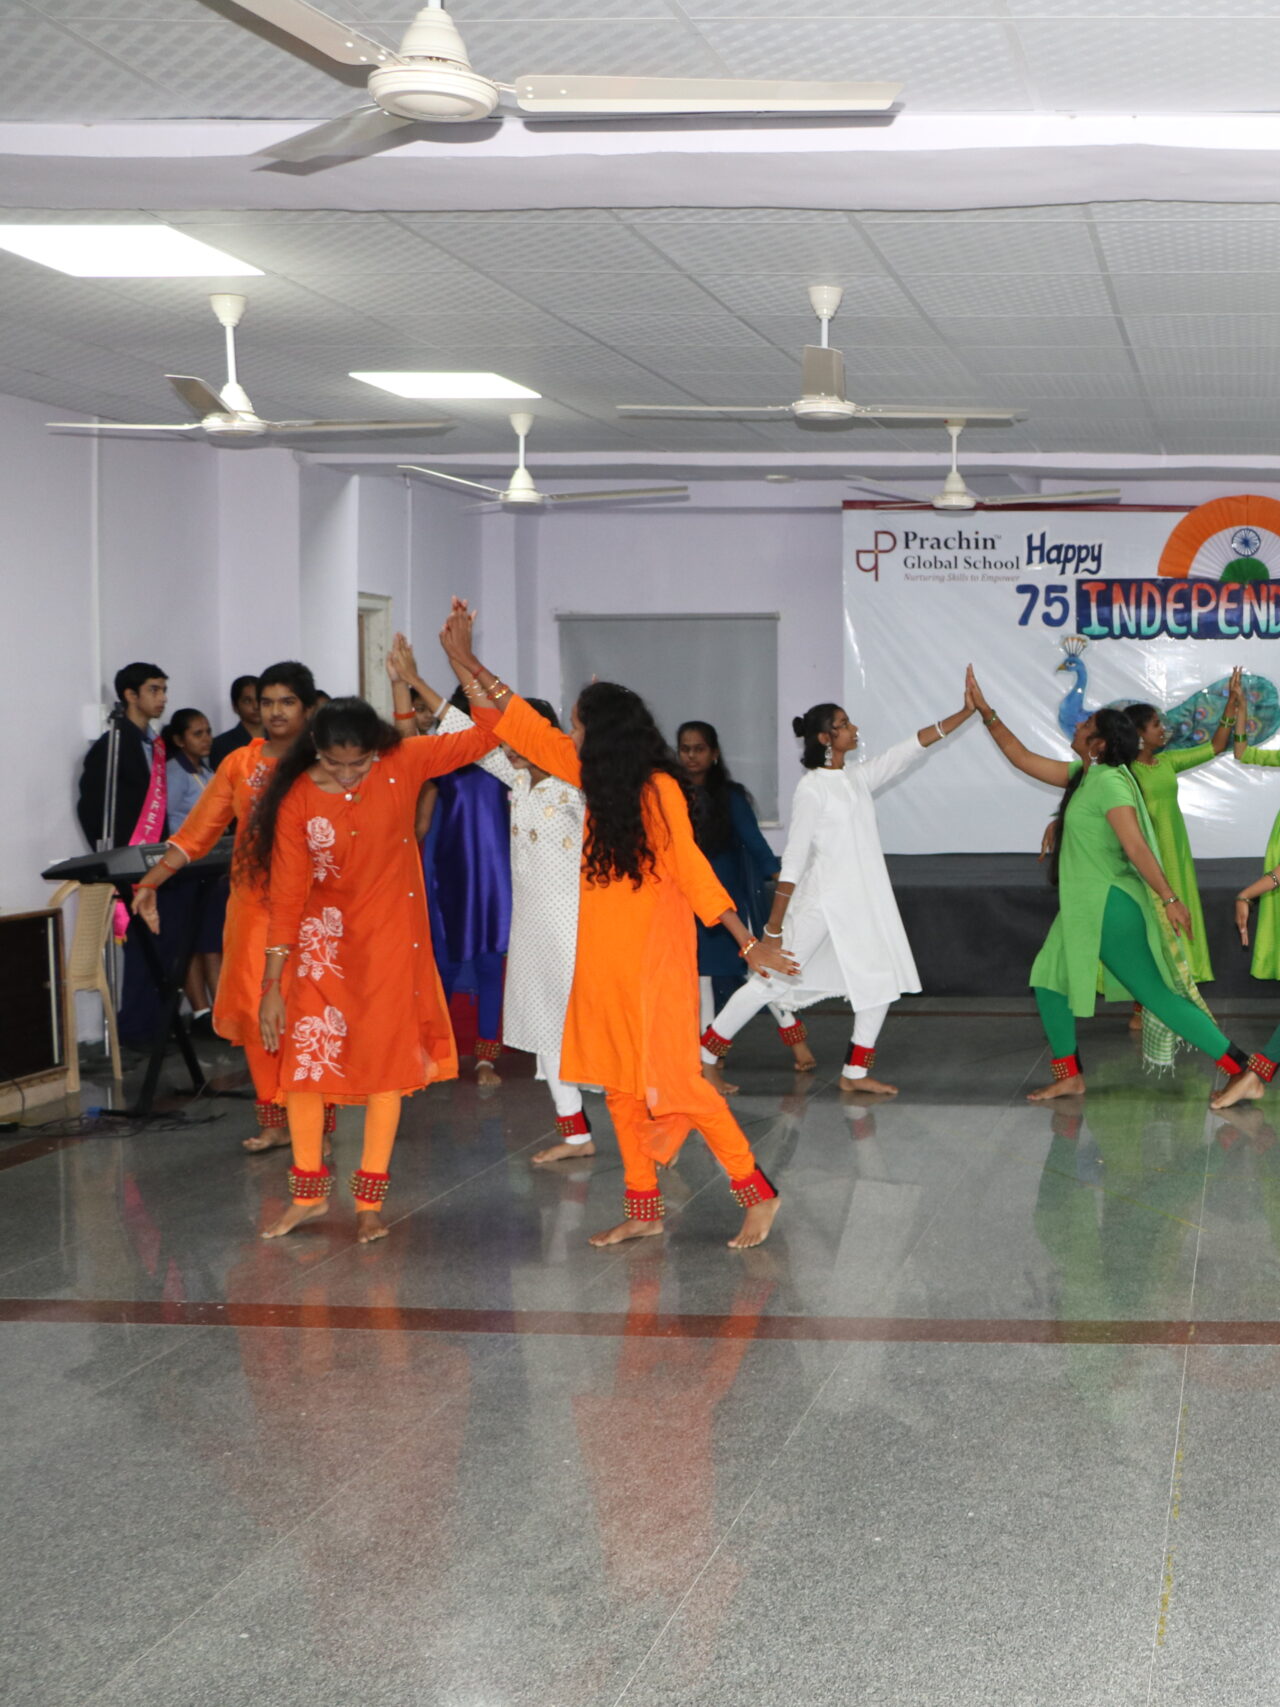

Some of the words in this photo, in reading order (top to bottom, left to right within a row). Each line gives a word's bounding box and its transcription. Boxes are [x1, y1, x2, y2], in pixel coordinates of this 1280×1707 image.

[903, 530, 997, 550] Prachin
[903, 555, 958, 570] Global
[963, 555, 1020, 570] School
[1025, 531, 1103, 576] Happy
[947, 573, 969, 582] Skills
[970, 574, 979, 582] to
[981, 573, 1020, 583] Empower
[1015, 584, 1070, 628] 75
